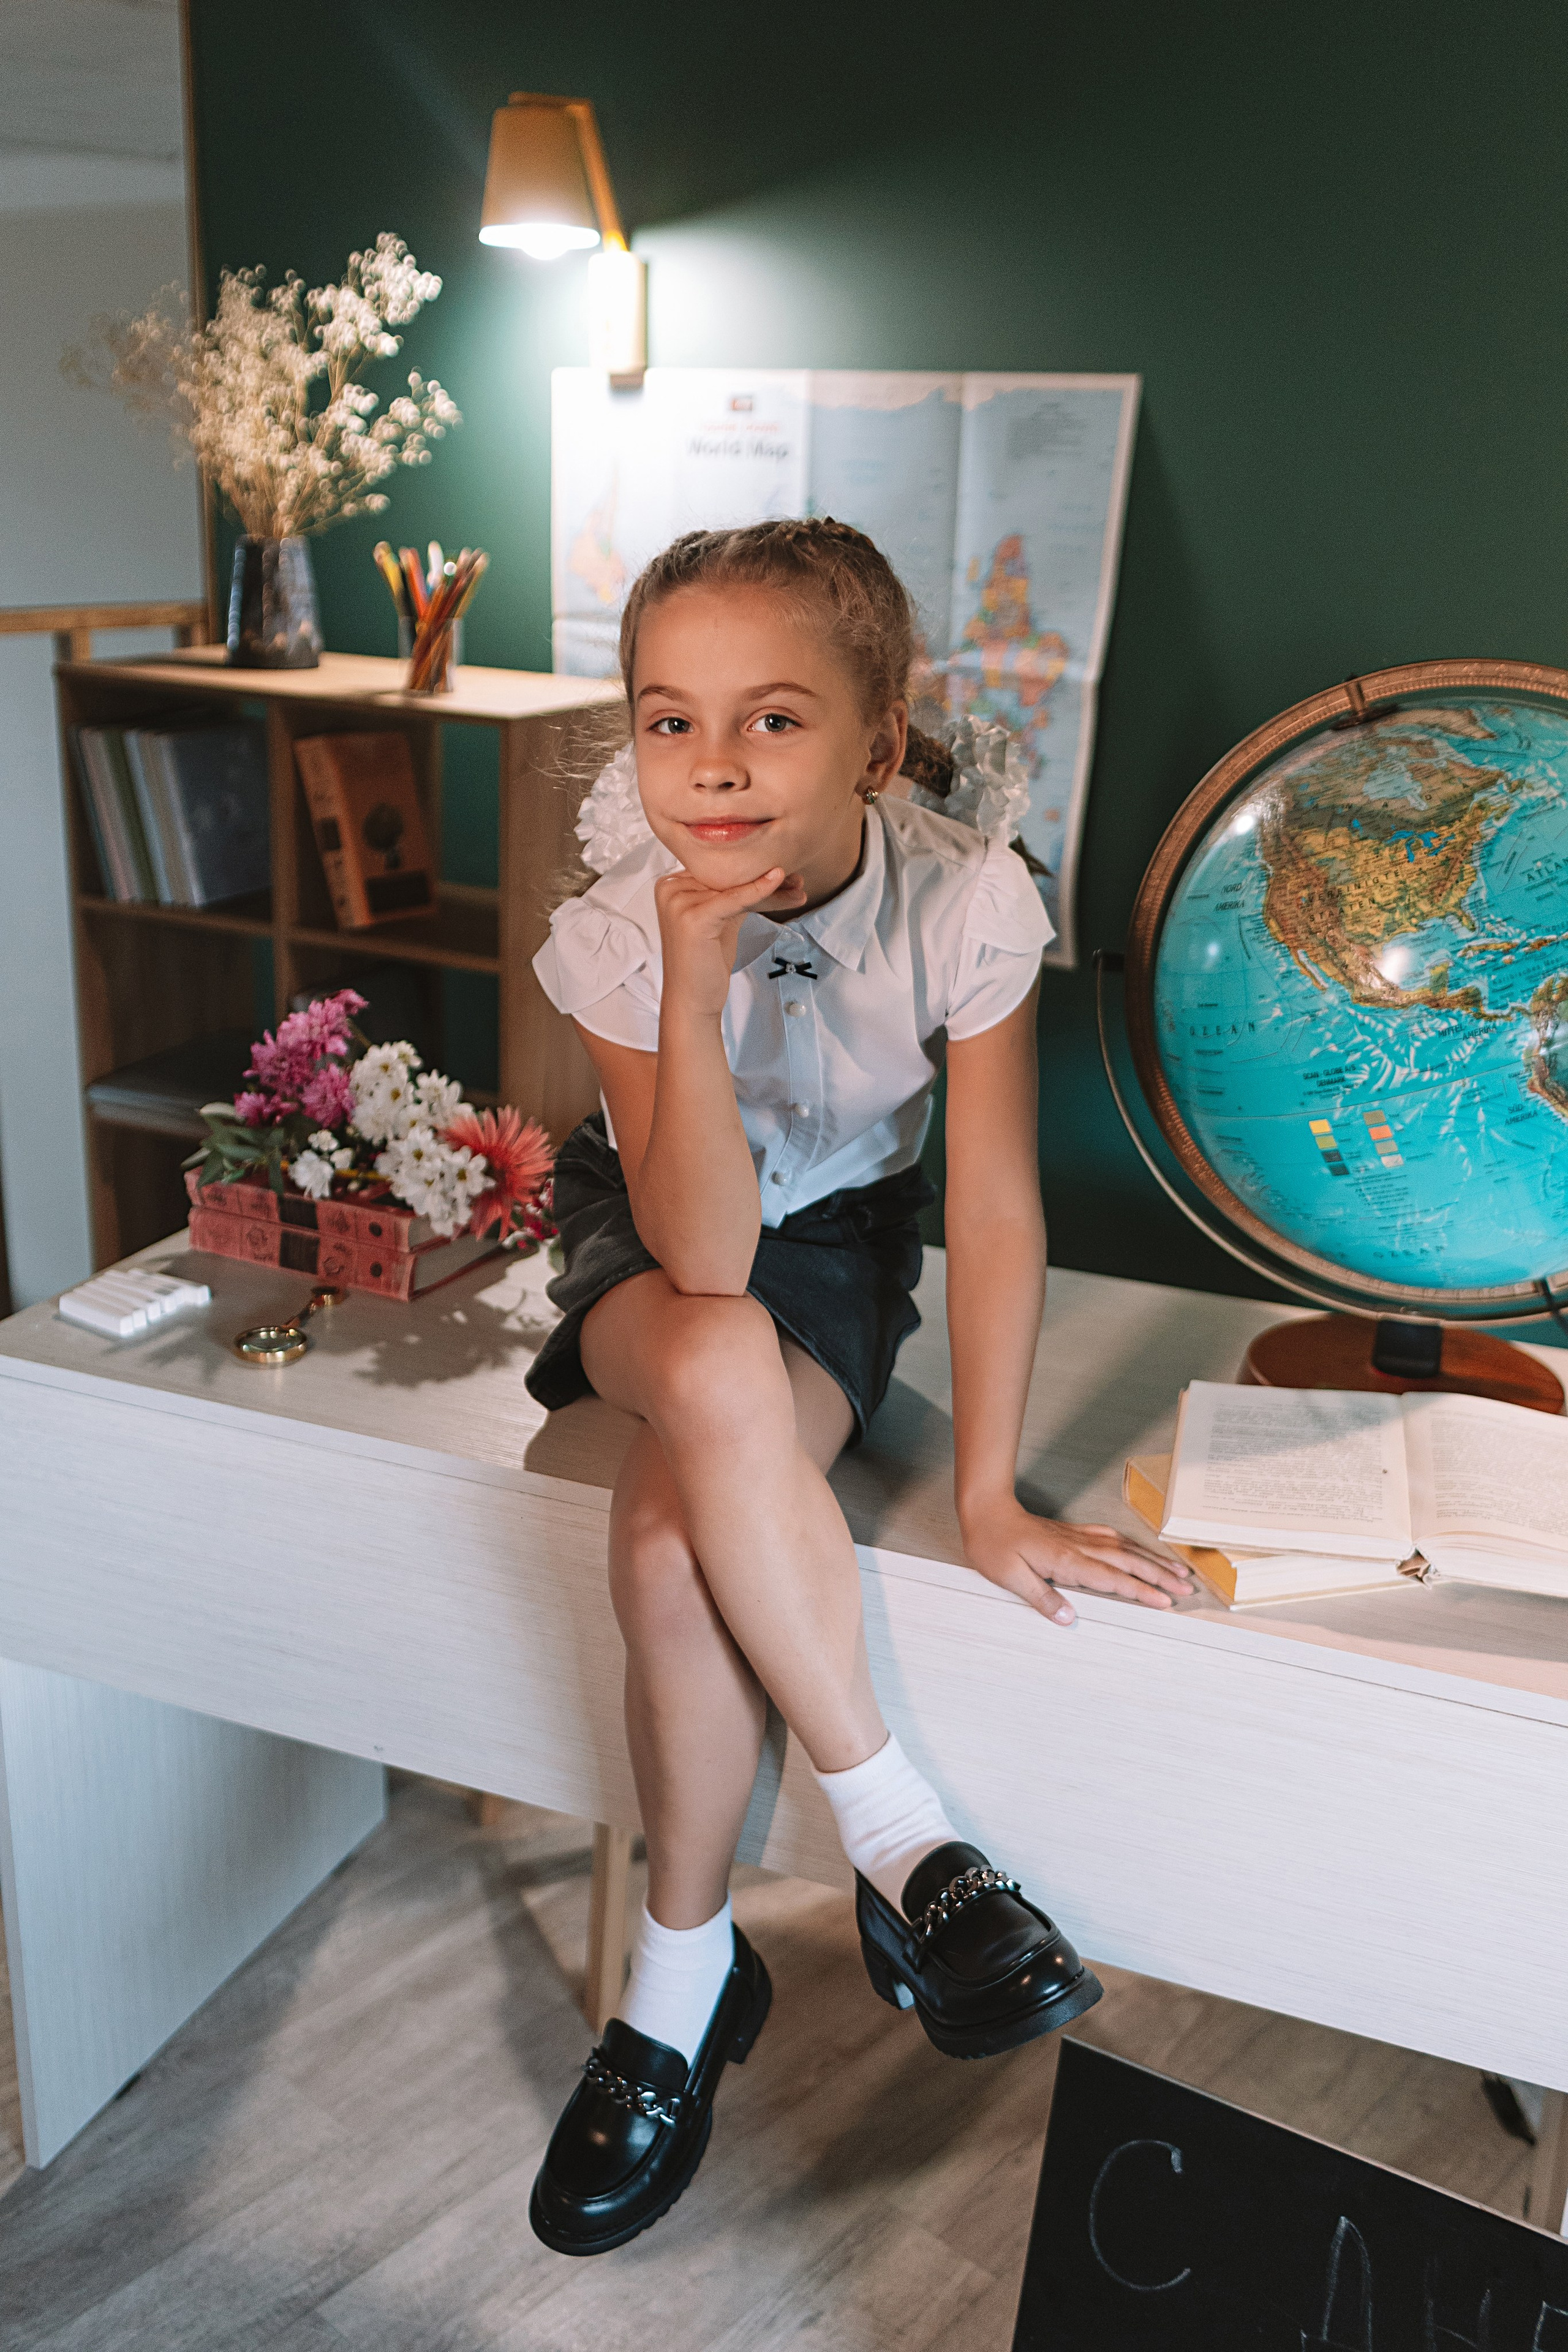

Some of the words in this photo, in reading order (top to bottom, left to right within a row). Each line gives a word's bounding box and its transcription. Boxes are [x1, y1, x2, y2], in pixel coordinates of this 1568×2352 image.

[687, 437, 741, 457] World
[747, 438, 789, 462] Map
[1308, 869, 1400, 903] VEREINIGTE
[1214, 899, 1245, 911] AMERIKA
[1310, 897, 1376, 922] STAATEN
[1189, 1021, 1256, 1036] OZEAN
[1462, 1024, 1497, 1041] AMERIKA
[1316, 1076, 1346, 1087] DENMARK
[1505, 1110, 1538, 1126] AMERIKA
